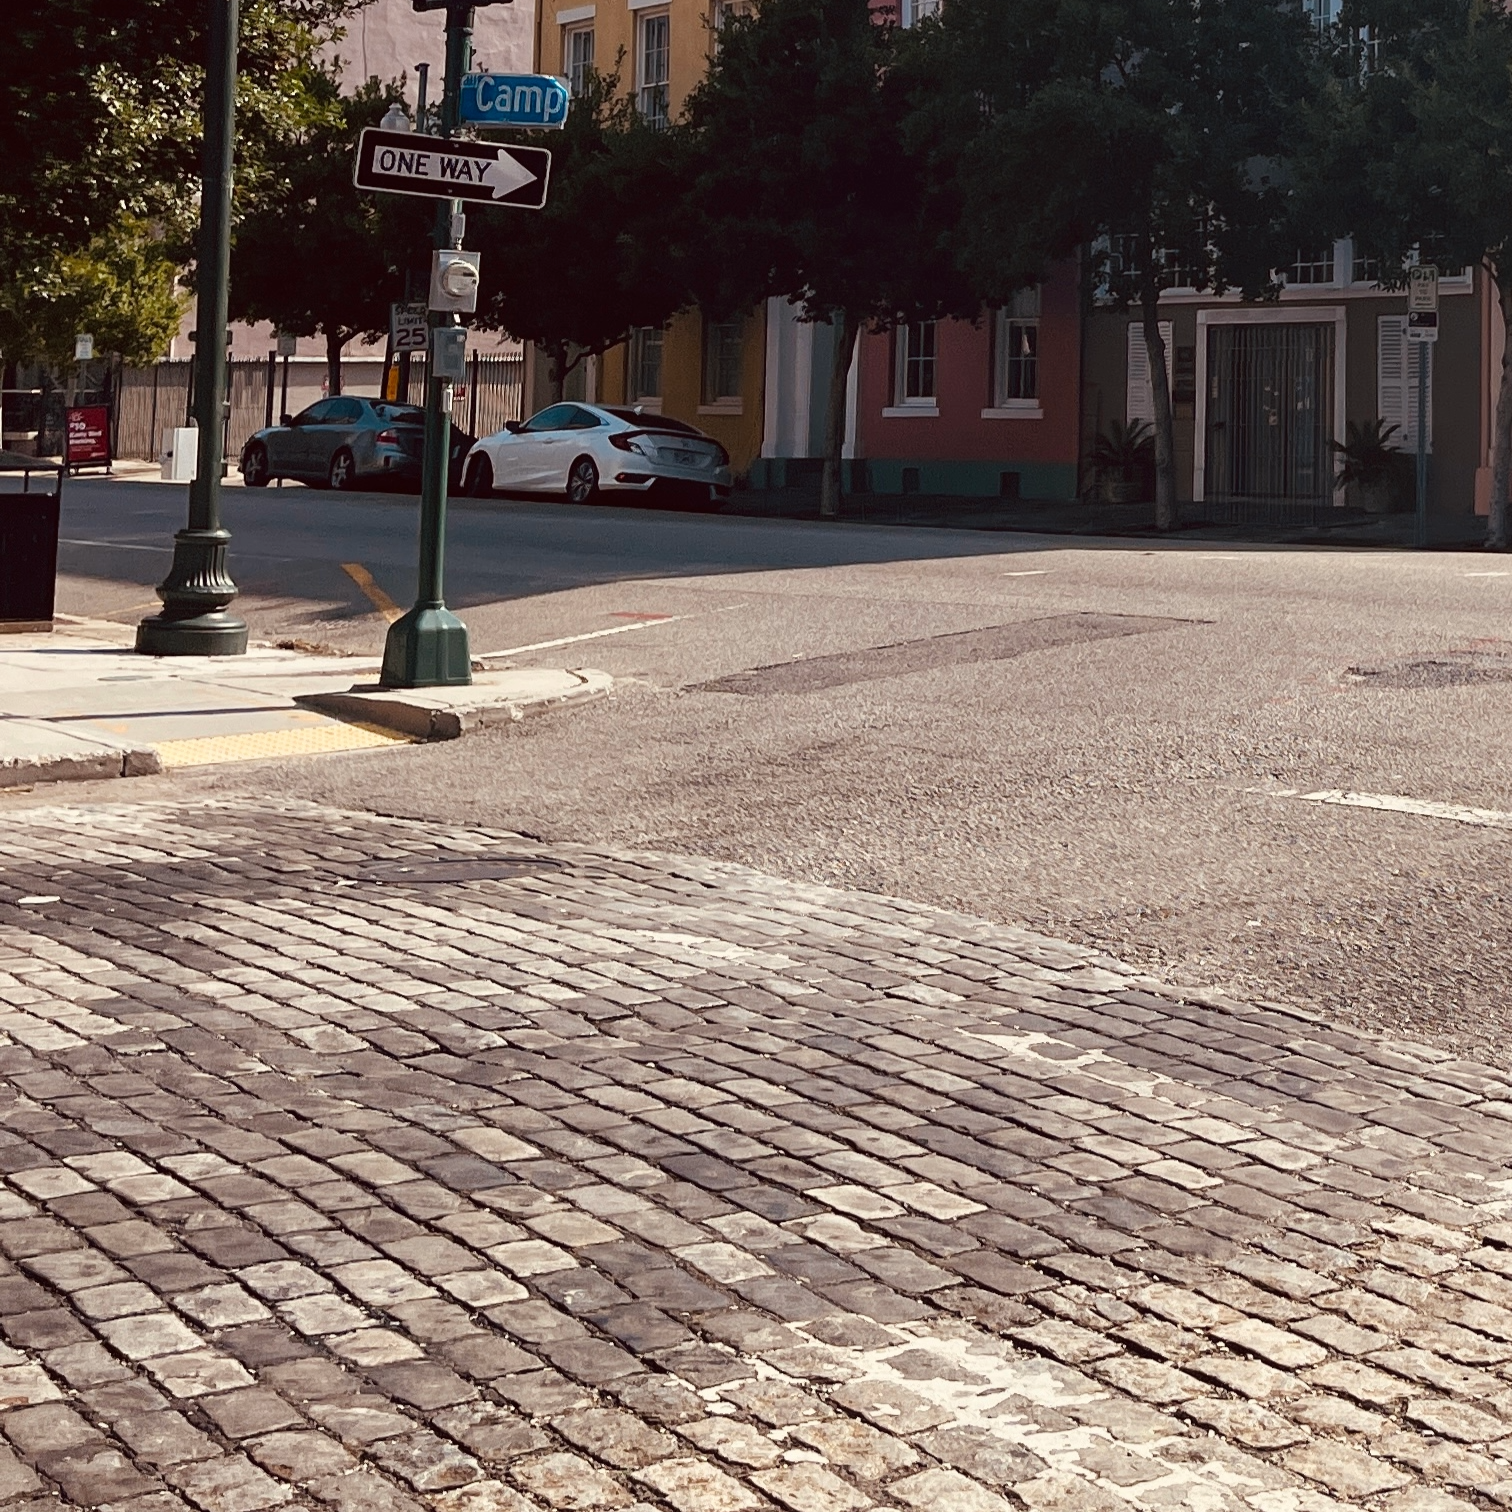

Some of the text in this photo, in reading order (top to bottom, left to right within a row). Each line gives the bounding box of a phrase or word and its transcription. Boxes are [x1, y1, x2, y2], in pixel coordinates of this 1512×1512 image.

[476, 76, 564, 122] Camp
[379, 149, 491, 182] ONE WAY
[397, 317, 424, 326] LIMIT
[396, 328, 427, 347] 25
